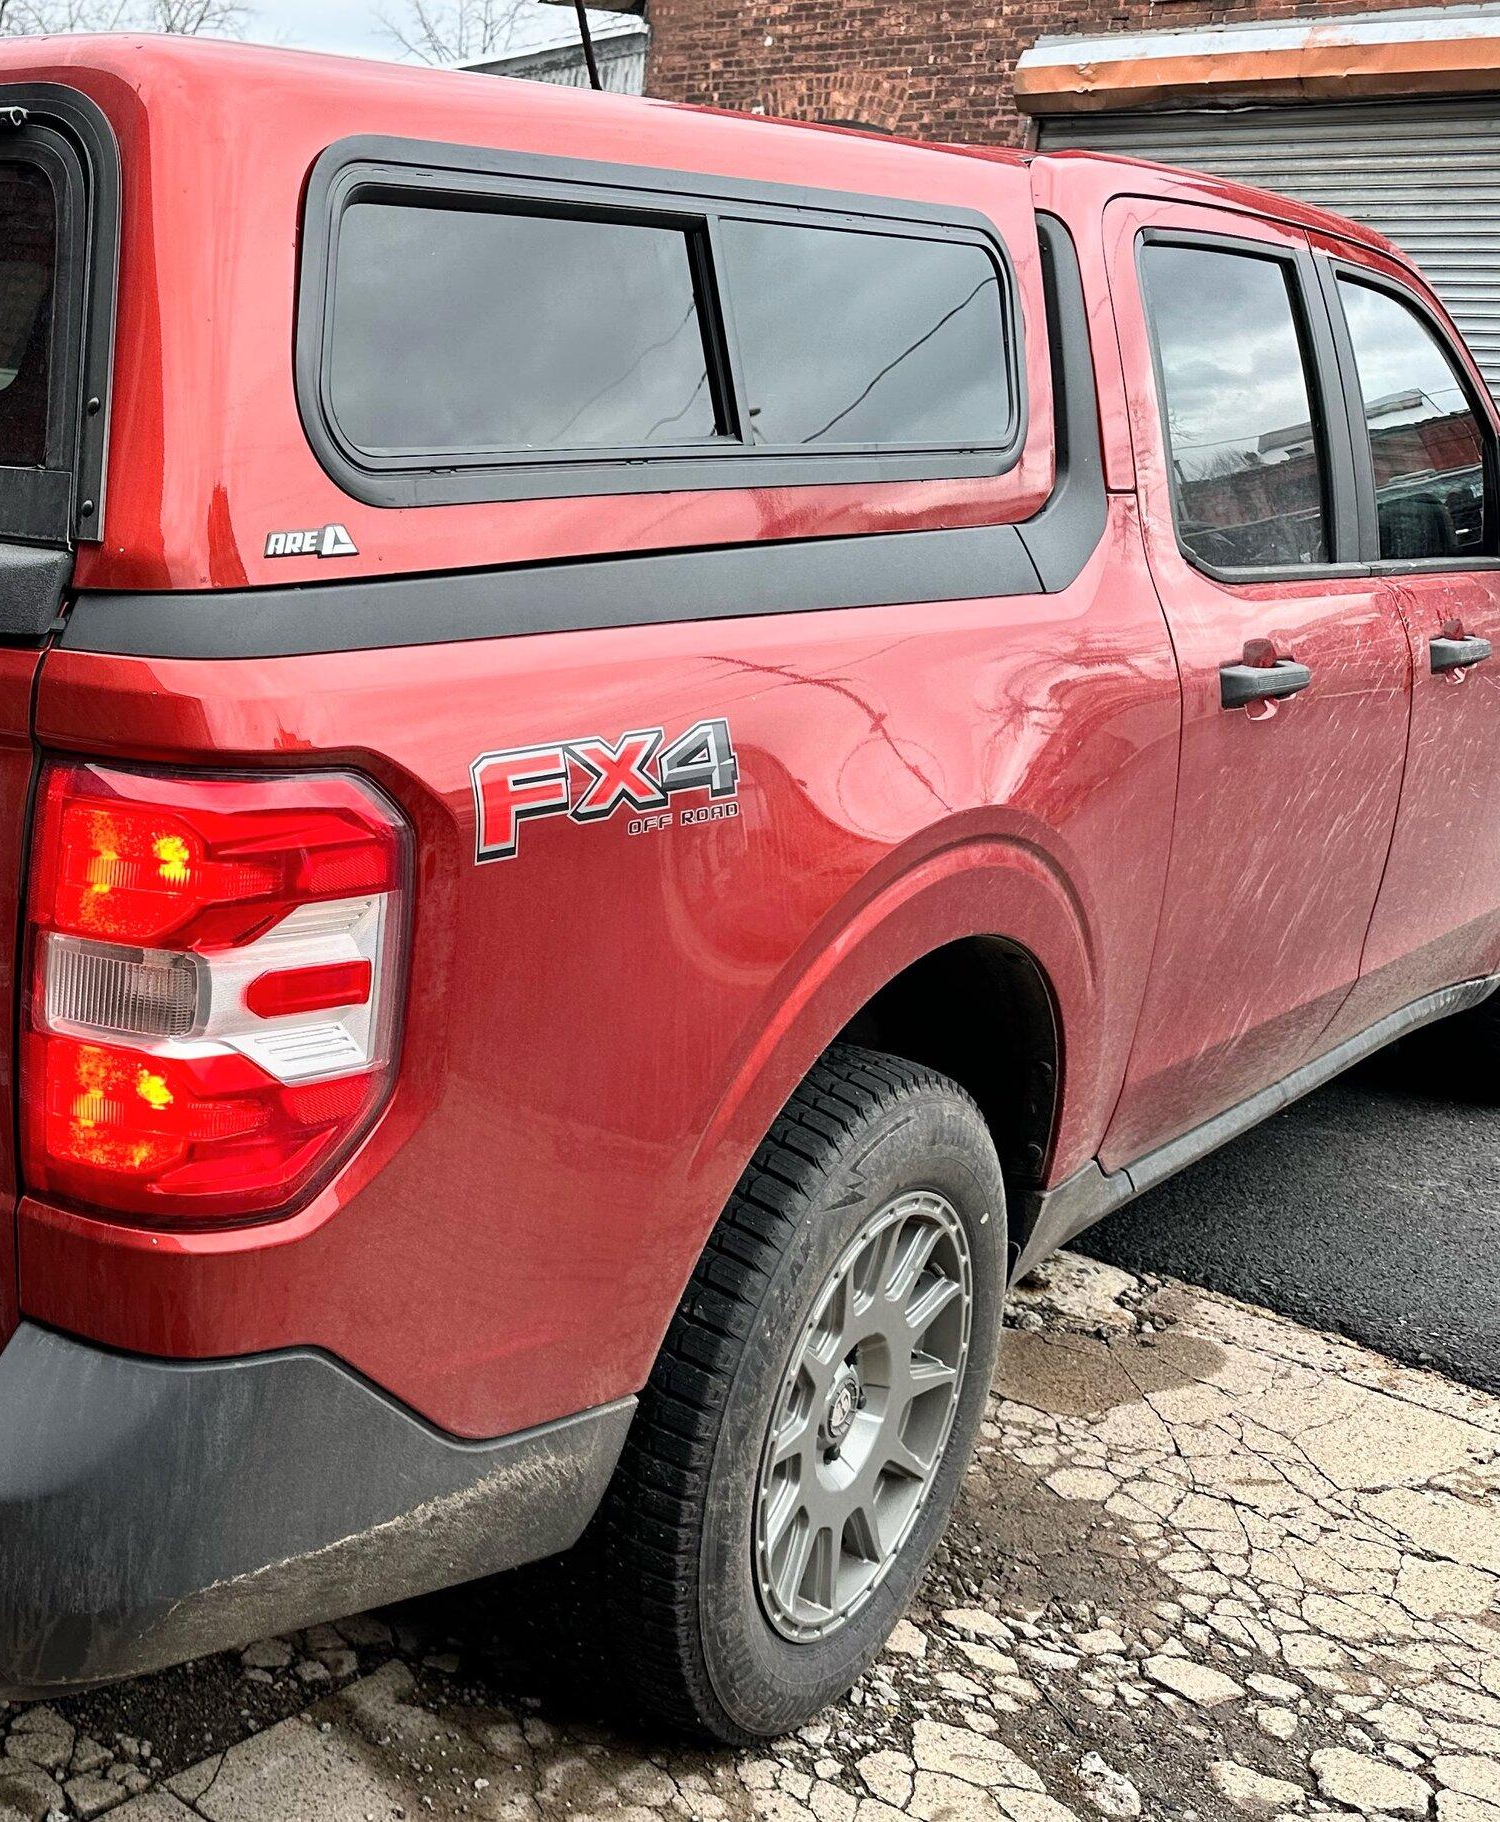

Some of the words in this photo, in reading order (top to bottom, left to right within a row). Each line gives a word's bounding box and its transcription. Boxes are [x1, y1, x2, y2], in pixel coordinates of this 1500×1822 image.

[266, 530, 319, 556] ARE
[468, 716, 740, 866] FX4
[627, 812, 674, 836] OFF
[680, 801, 740, 827] ROAD
